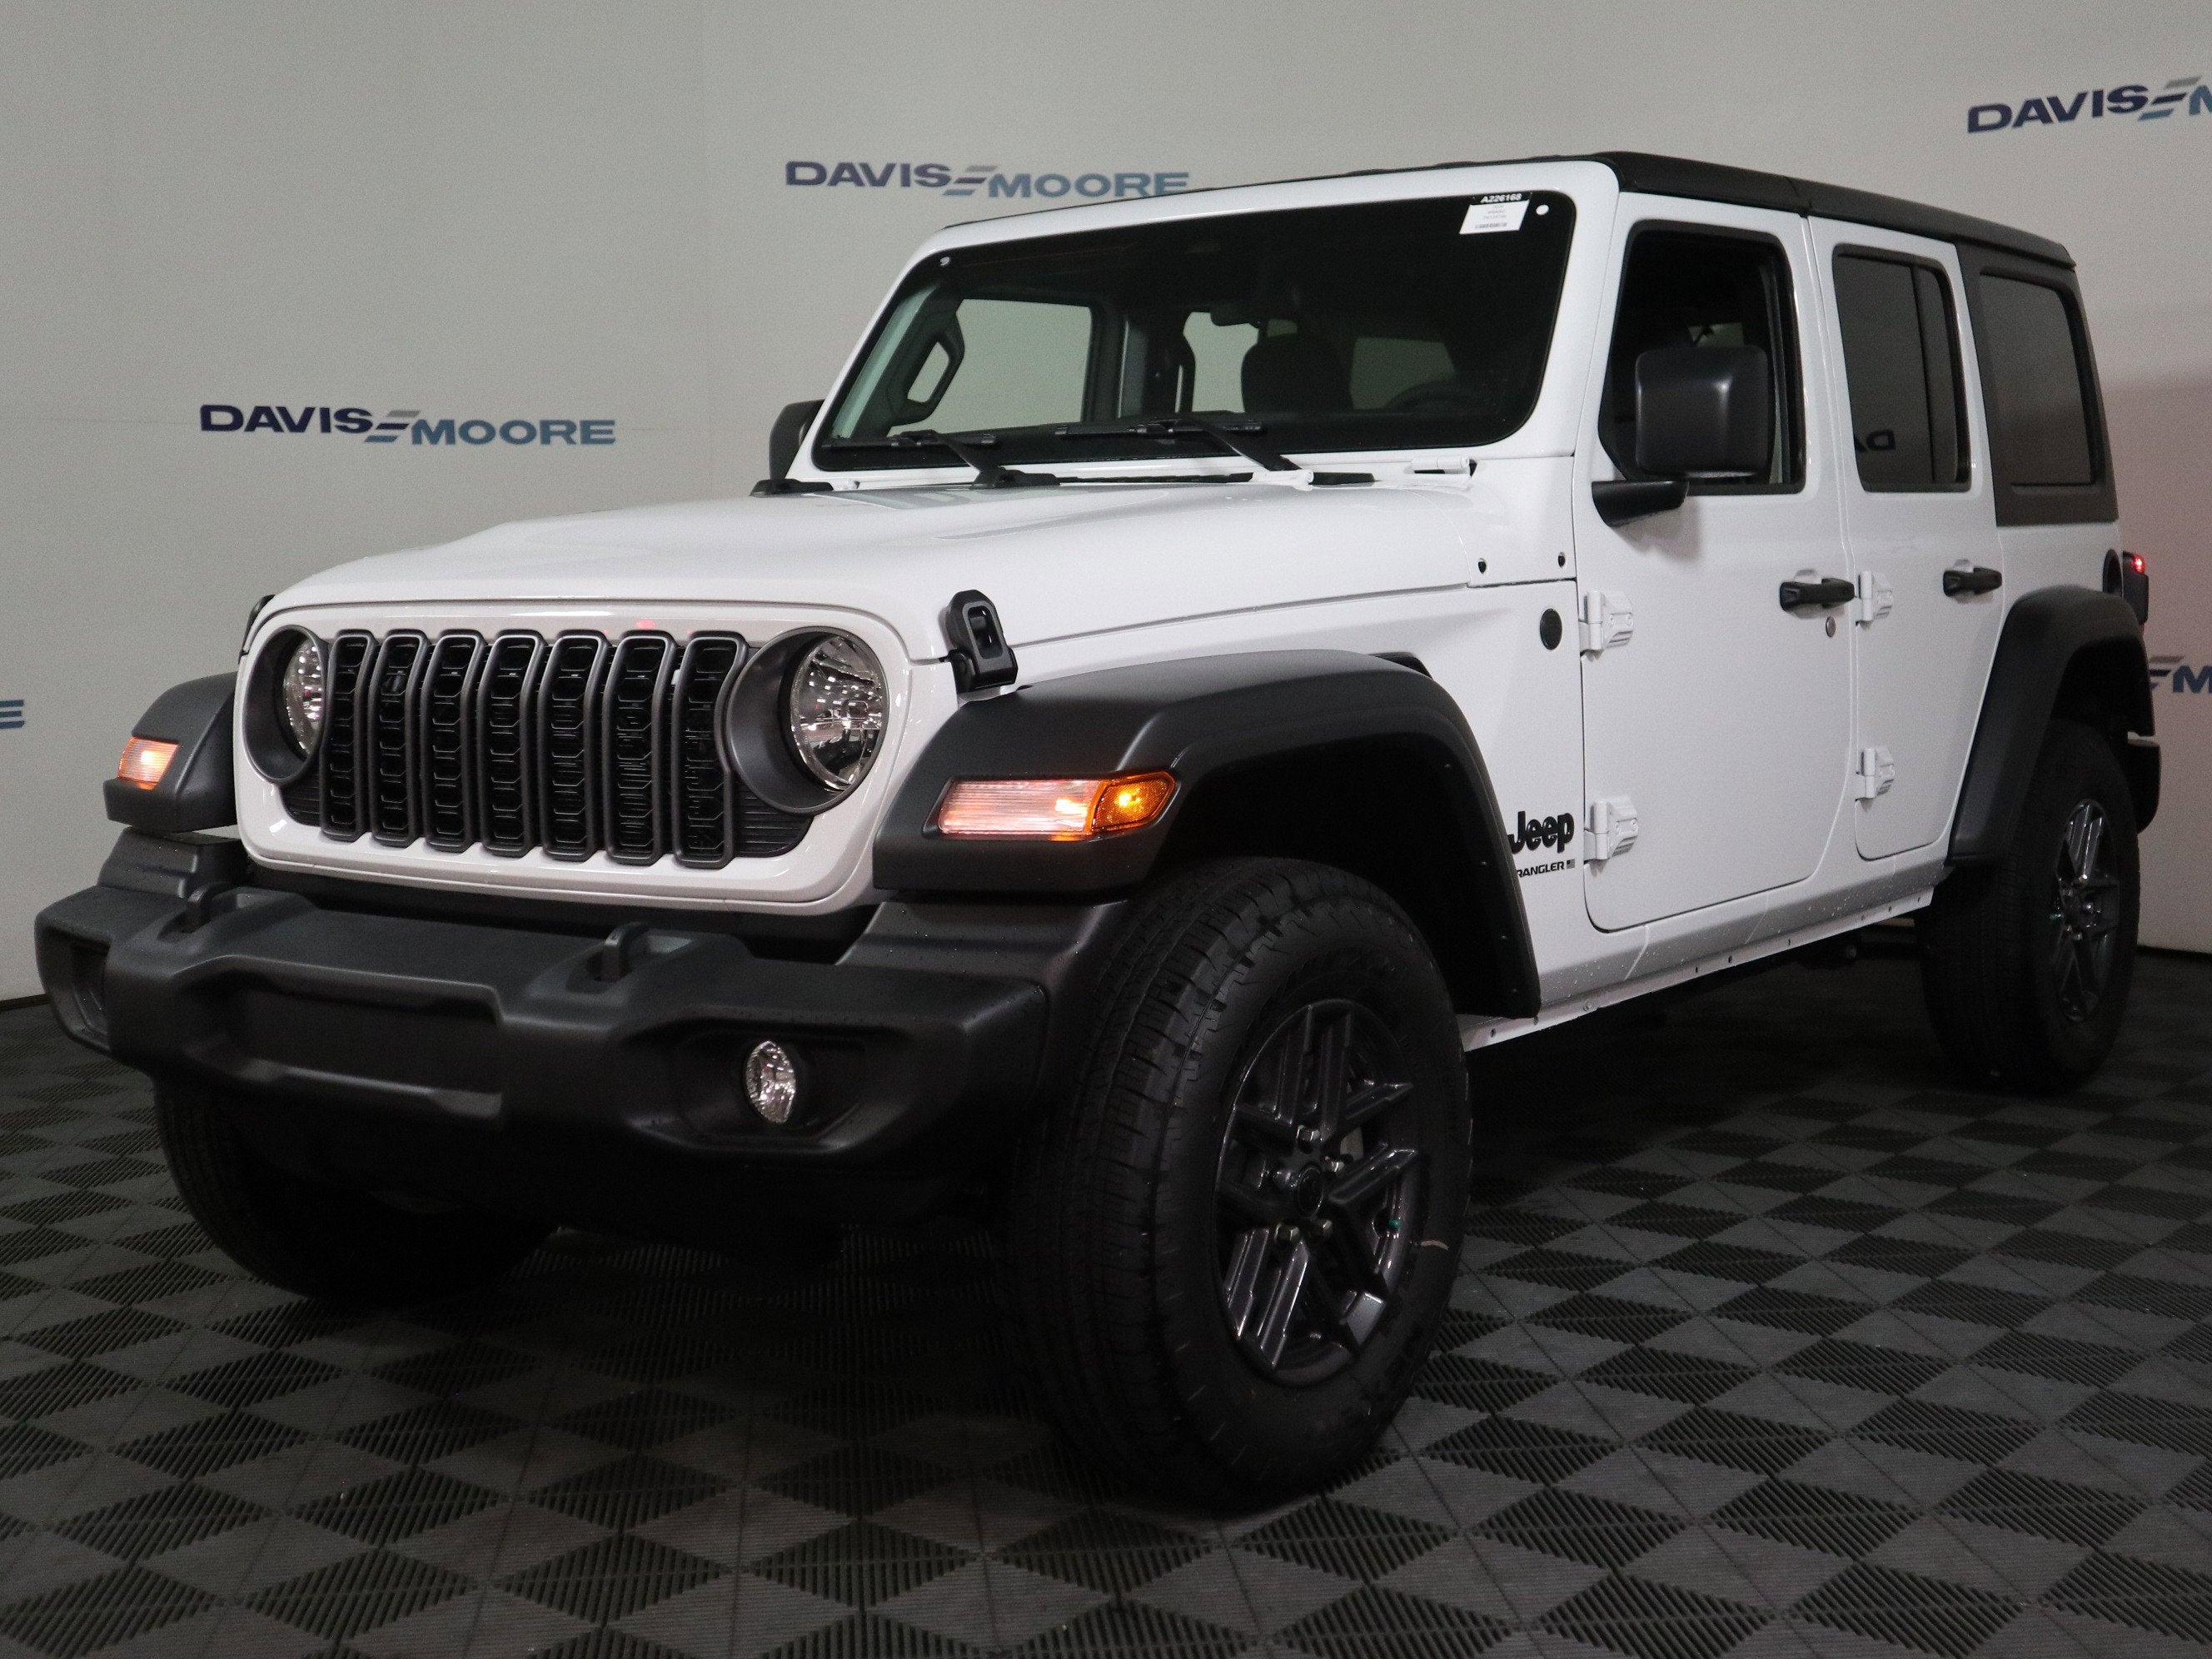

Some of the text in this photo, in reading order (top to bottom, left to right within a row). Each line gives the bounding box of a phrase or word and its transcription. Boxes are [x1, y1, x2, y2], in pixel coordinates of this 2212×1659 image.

[1967, 84, 2150, 134] DAVIS
[785, 161, 1189, 198] DAVIS MOORE
[200, 404, 616, 446] DAVIS MOORE
[1508, 810, 1574, 854] Jeep
[1517, 861, 1564, 878] RANGLER
